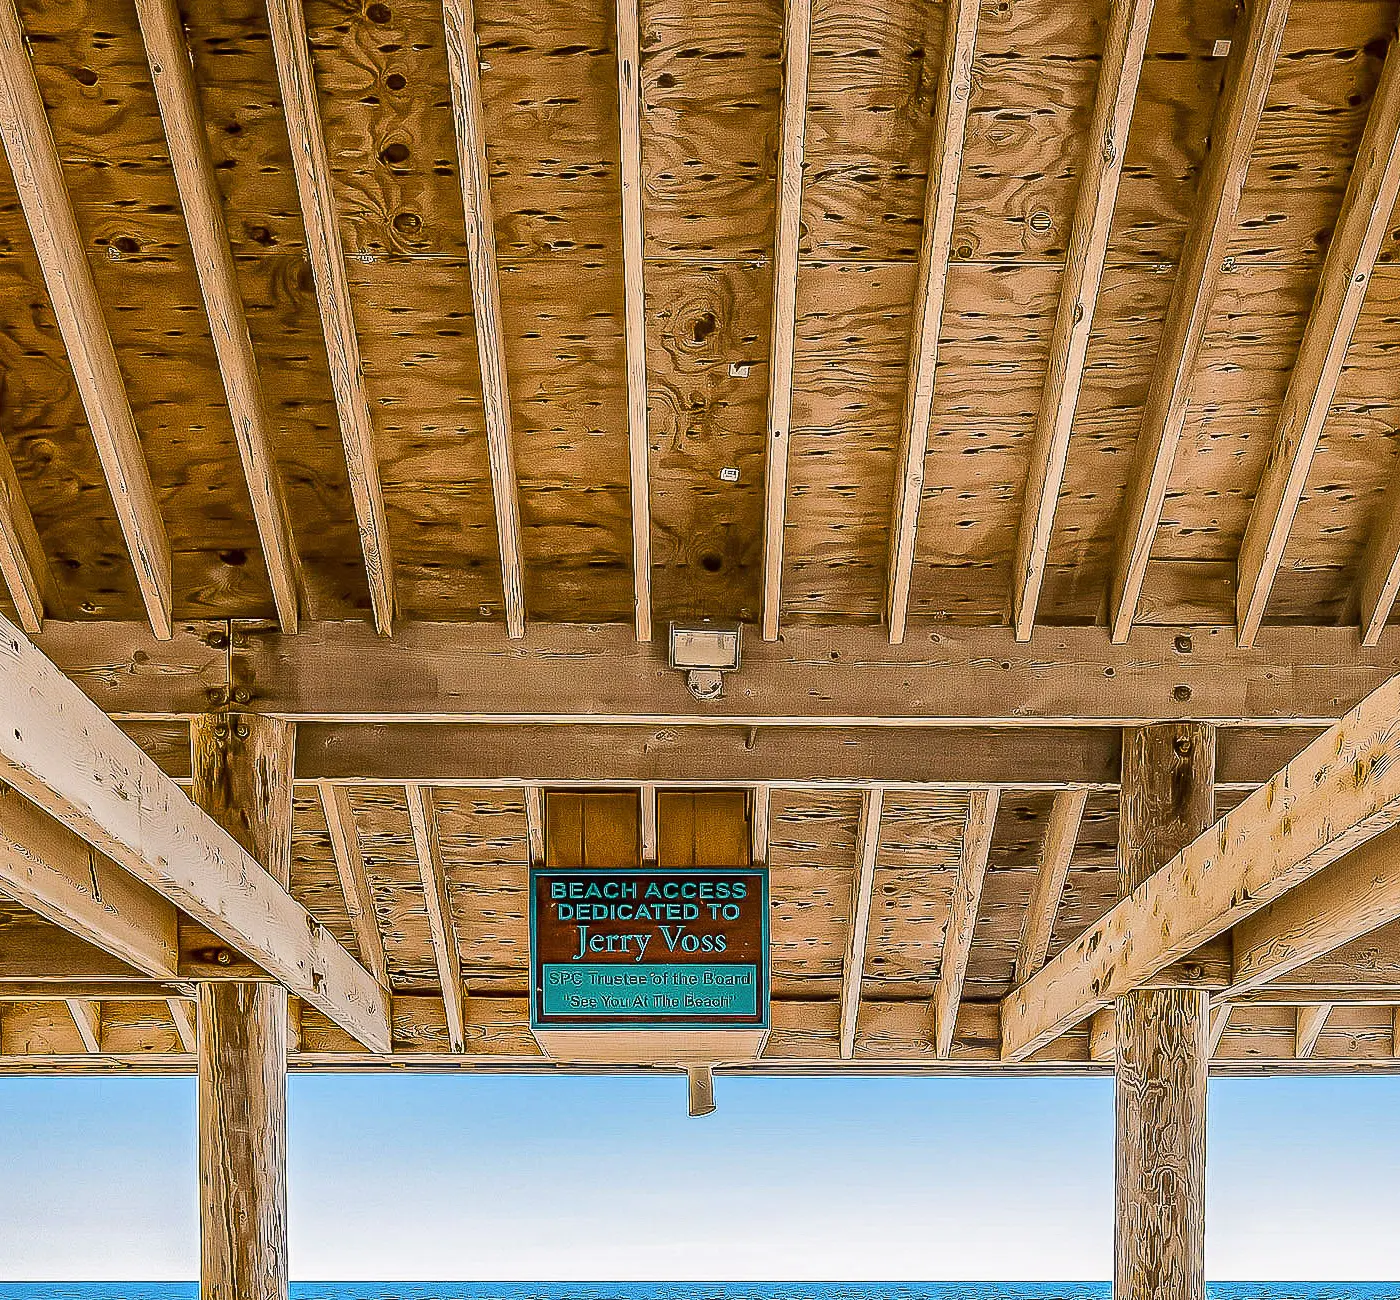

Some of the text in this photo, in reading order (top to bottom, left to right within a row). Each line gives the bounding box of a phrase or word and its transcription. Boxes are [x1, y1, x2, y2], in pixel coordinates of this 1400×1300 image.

[551, 882, 747, 899] BEACH ACCESS
[558, 903, 740, 921] DEDICATED TO
[572, 925, 727, 962] Jerry Voss
[549, 971, 753, 985] SPC Trustee of the Board
[602, 994, 629, 1008] You
[632, 994, 649, 1008] At
[653, 994, 679, 1008] The
